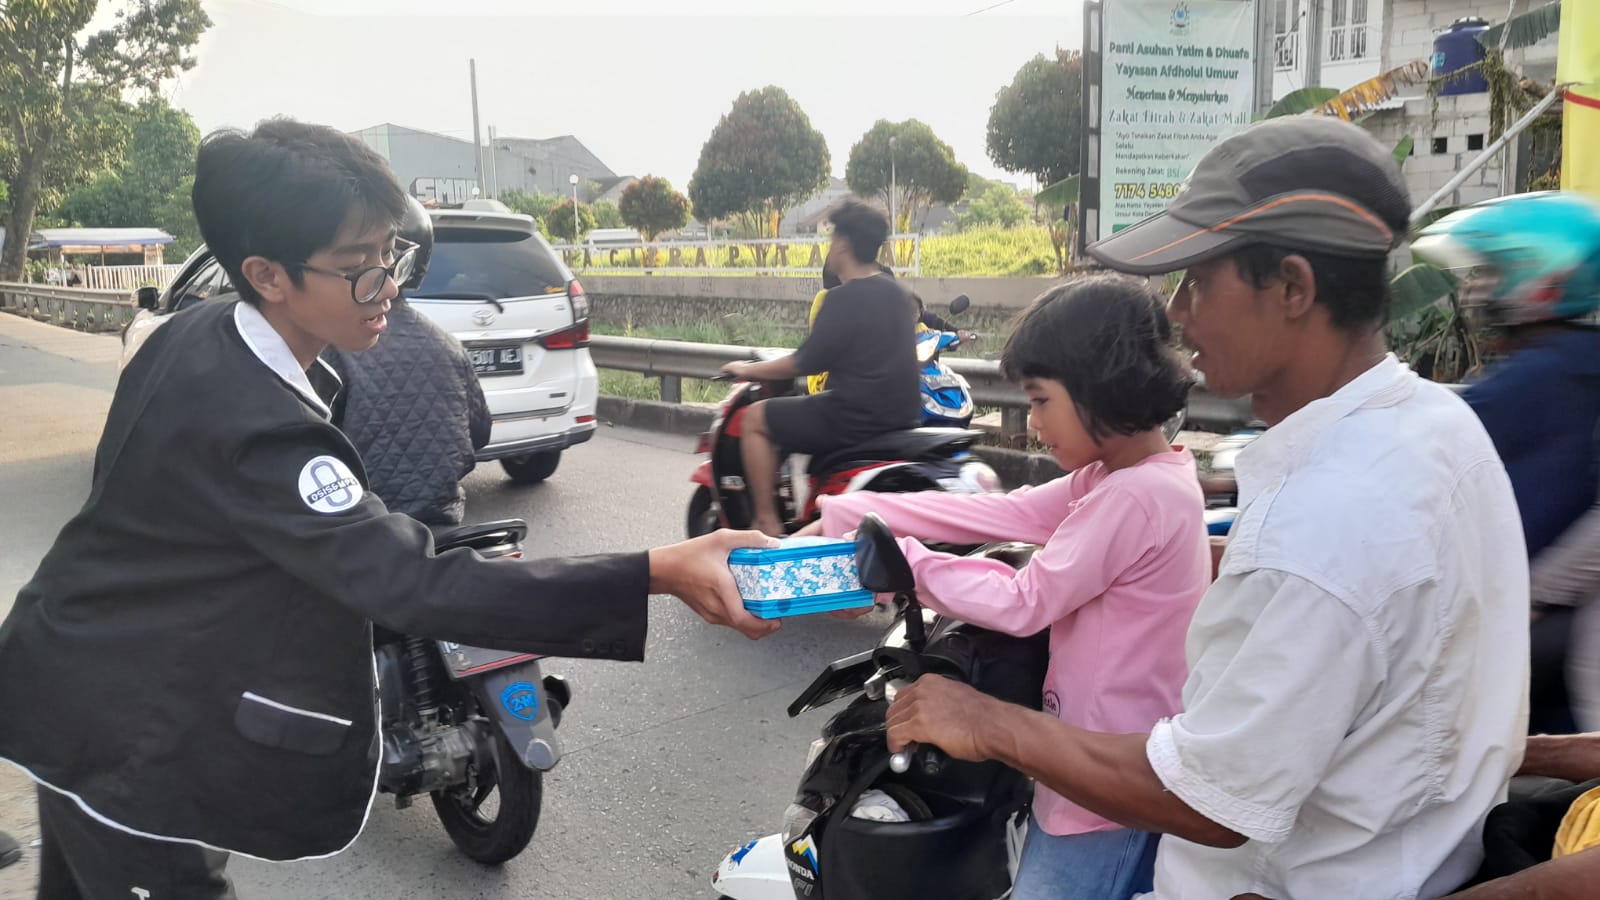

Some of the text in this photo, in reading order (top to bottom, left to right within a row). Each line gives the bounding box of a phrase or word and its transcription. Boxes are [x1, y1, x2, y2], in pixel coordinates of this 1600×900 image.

[1109, 42, 1250, 59] Panti Asuhan Yatim & Dhuafa
[1115, 63, 1239, 80] Yayasan Afdholul Umuur
[1125, 85, 1229, 104] Menerima & Menyalurkan
[1109, 109, 1138, 125] Zakat
[1142, 109, 1175, 124] Fitrah
[1190, 111, 1218, 126] Zakat
[1131, 132, 1155, 140] Tunaikan
[1156, 132, 1172, 140] Zakat
[1115, 153, 1153, 161] Mendapatkan
[1115, 167, 1146, 177] Rekening
[1147, 168, 1164, 176] Zakat:
[1114, 183, 1146, 199] 7174
